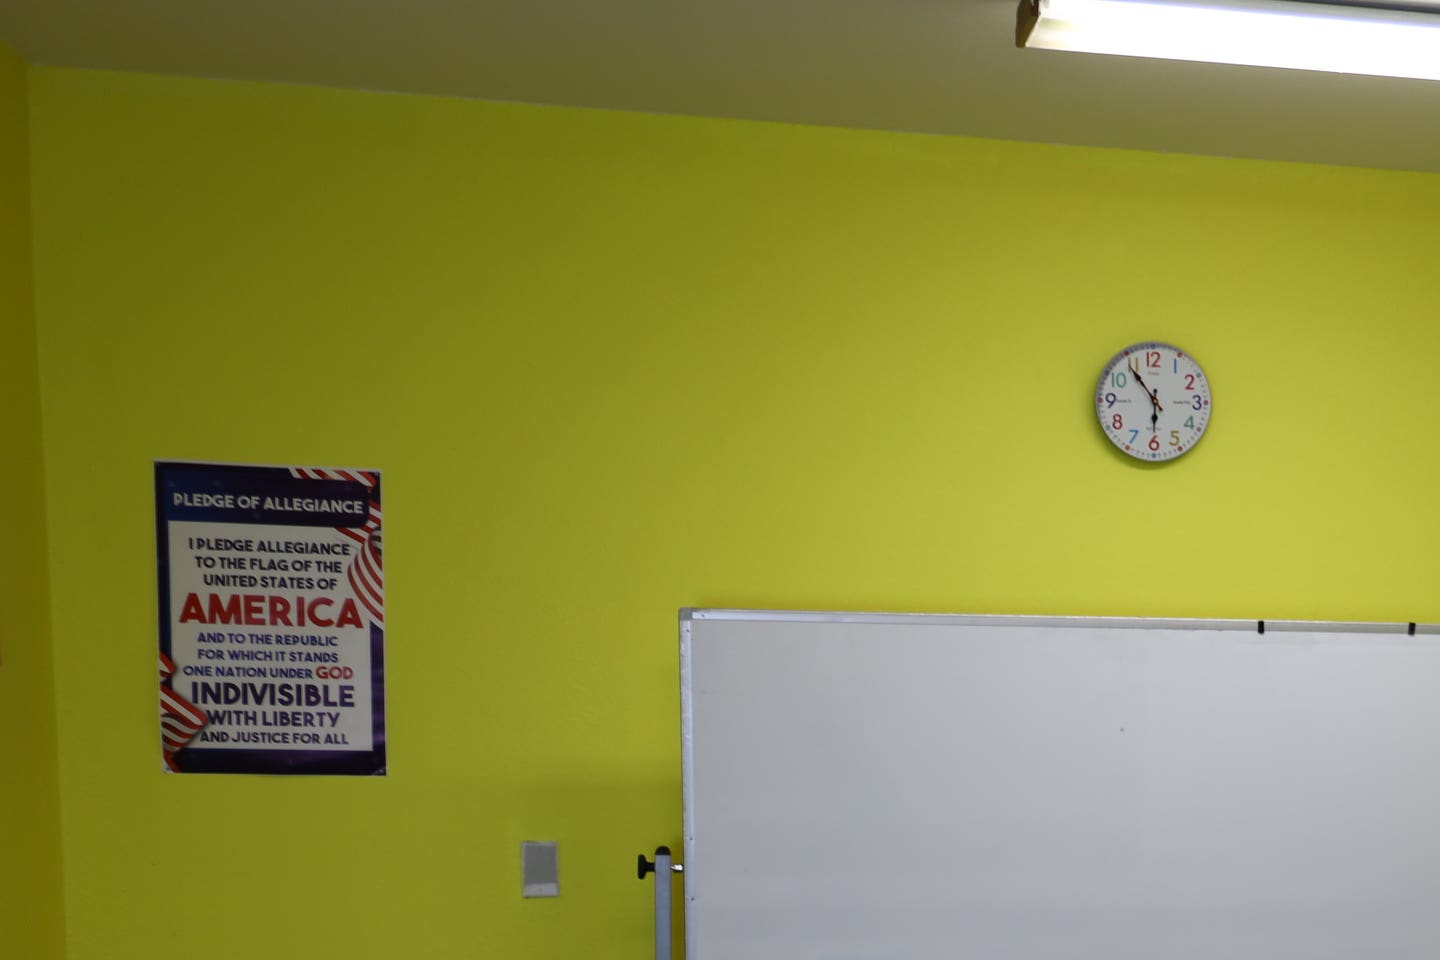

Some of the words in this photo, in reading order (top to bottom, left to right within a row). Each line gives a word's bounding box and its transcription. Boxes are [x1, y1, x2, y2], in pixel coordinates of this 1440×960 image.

[1128, 357, 1139, 373] 11
[1146, 351, 1161, 368] 12
[1173, 358, 1178, 374] 1
[1111, 372, 1127, 389] 10
[1184, 374, 1195, 391] 2
[1105, 392, 1117, 409] 9
[1192, 394, 1202, 411] 3
[1112, 413, 1123, 430] 8
[1183, 415, 1195, 430] 4
[1128, 429, 1139, 444] 7
[1148, 435, 1160, 451] 6
[1168, 430, 1180, 446] 5
[173, 492, 235, 508] PLEDGE
[237, 496, 260, 510] OF
[263, 497, 364, 514] ALLEGIANCE
[197, 538, 253, 552] PLEDGE
[257, 541, 350, 556] ALLEGIANCE
[195, 556, 216, 568] TO
[218, 557, 246, 570] THE
[250, 558, 288, 572] FLAG
[292, 560, 312, 573] OF
[315, 560, 343, 574] THE
[203, 574, 257, 588] UNITED
[260, 576, 314, 590] STATES
[317, 578, 338, 591] OF
[178, 592, 364, 629] AMERICA
[197, 632, 225, 645] AND
[227, 633, 246, 645] TO
[249, 633, 273, 646] THE
[275, 634, 338, 647] REPUBLIC
[197, 649, 225, 661] FOR
[229, 649, 272, 662] WHICH
[275, 650, 287, 662] IT
[289, 651, 338, 663] STANDS
[183, 665, 212, 677] ONE
[215, 666, 267, 678] NATION
[270, 667, 313, 680] UNDER
[315, 666, 354, 681] GOD
[191, 681, 356, 708] INDIVISIBLE
[206, 709, 258, 726] WITH
[262, 711, 341, 728] LIBERTY
[200, 731, 230, 743] AND
[232, 732, 290, 744] JUSTICE
[293, 733, 321, 745] FOR
[324, 733, 350, 745] ALL
